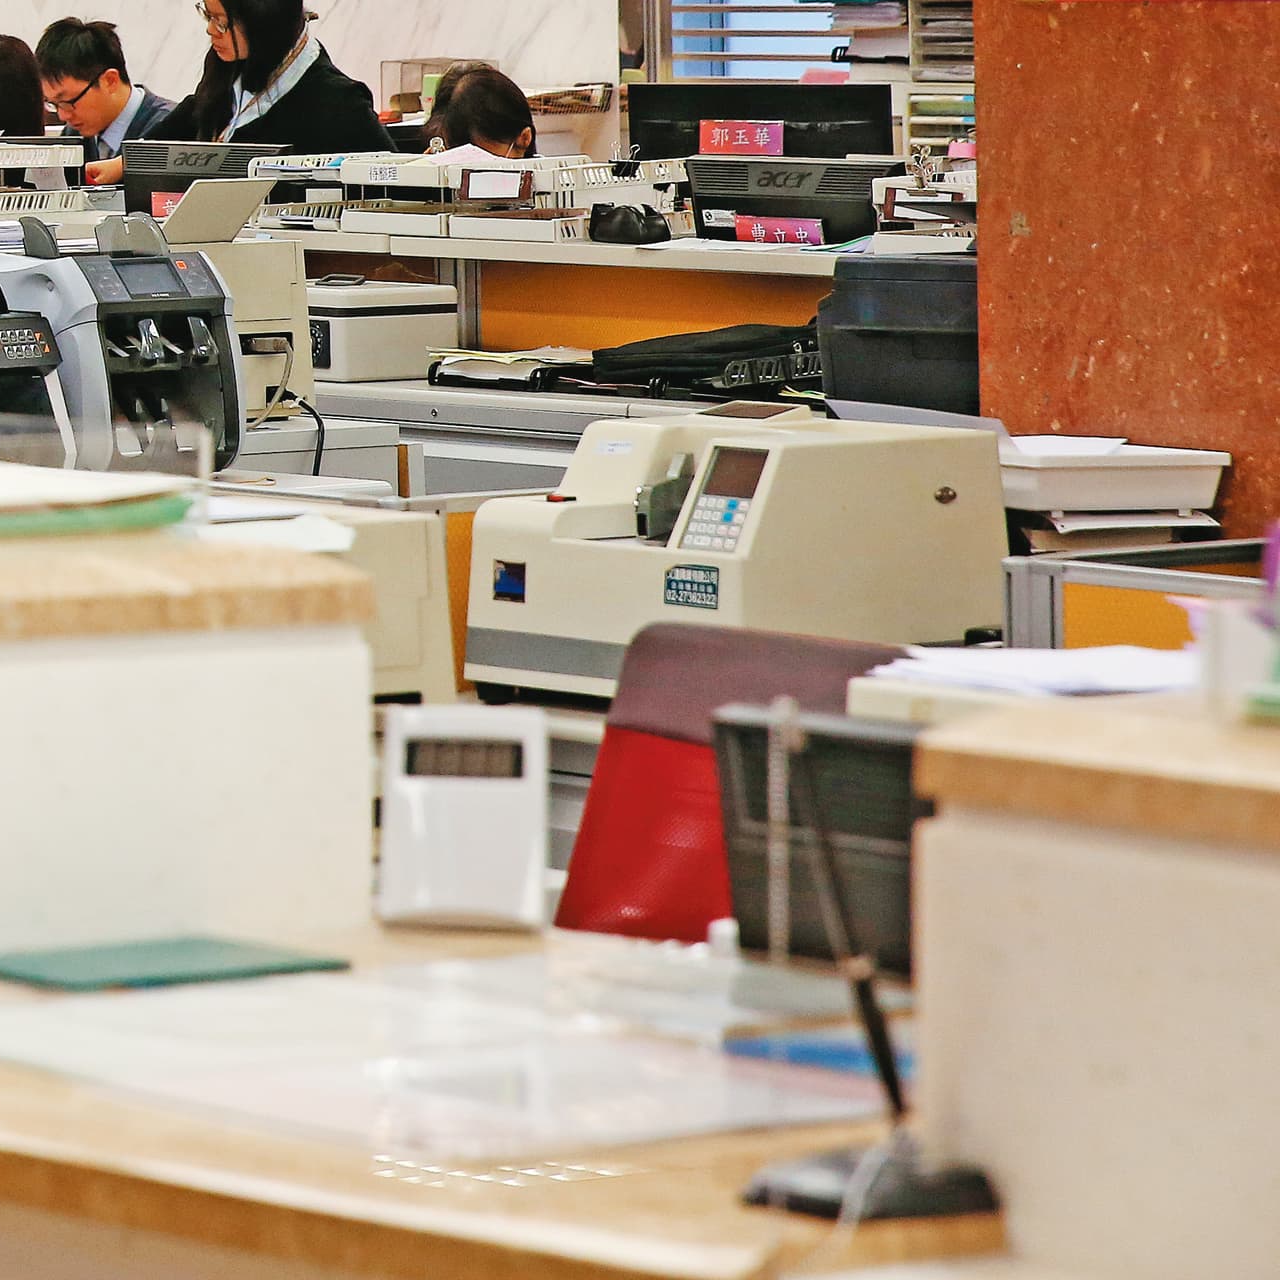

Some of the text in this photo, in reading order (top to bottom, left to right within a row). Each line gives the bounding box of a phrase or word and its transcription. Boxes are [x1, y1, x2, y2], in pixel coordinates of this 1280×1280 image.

[710, 127, 771, 148] 郭玉華
[173, 151, 219, 167] acer
[757, 170, 813, 189] acer
